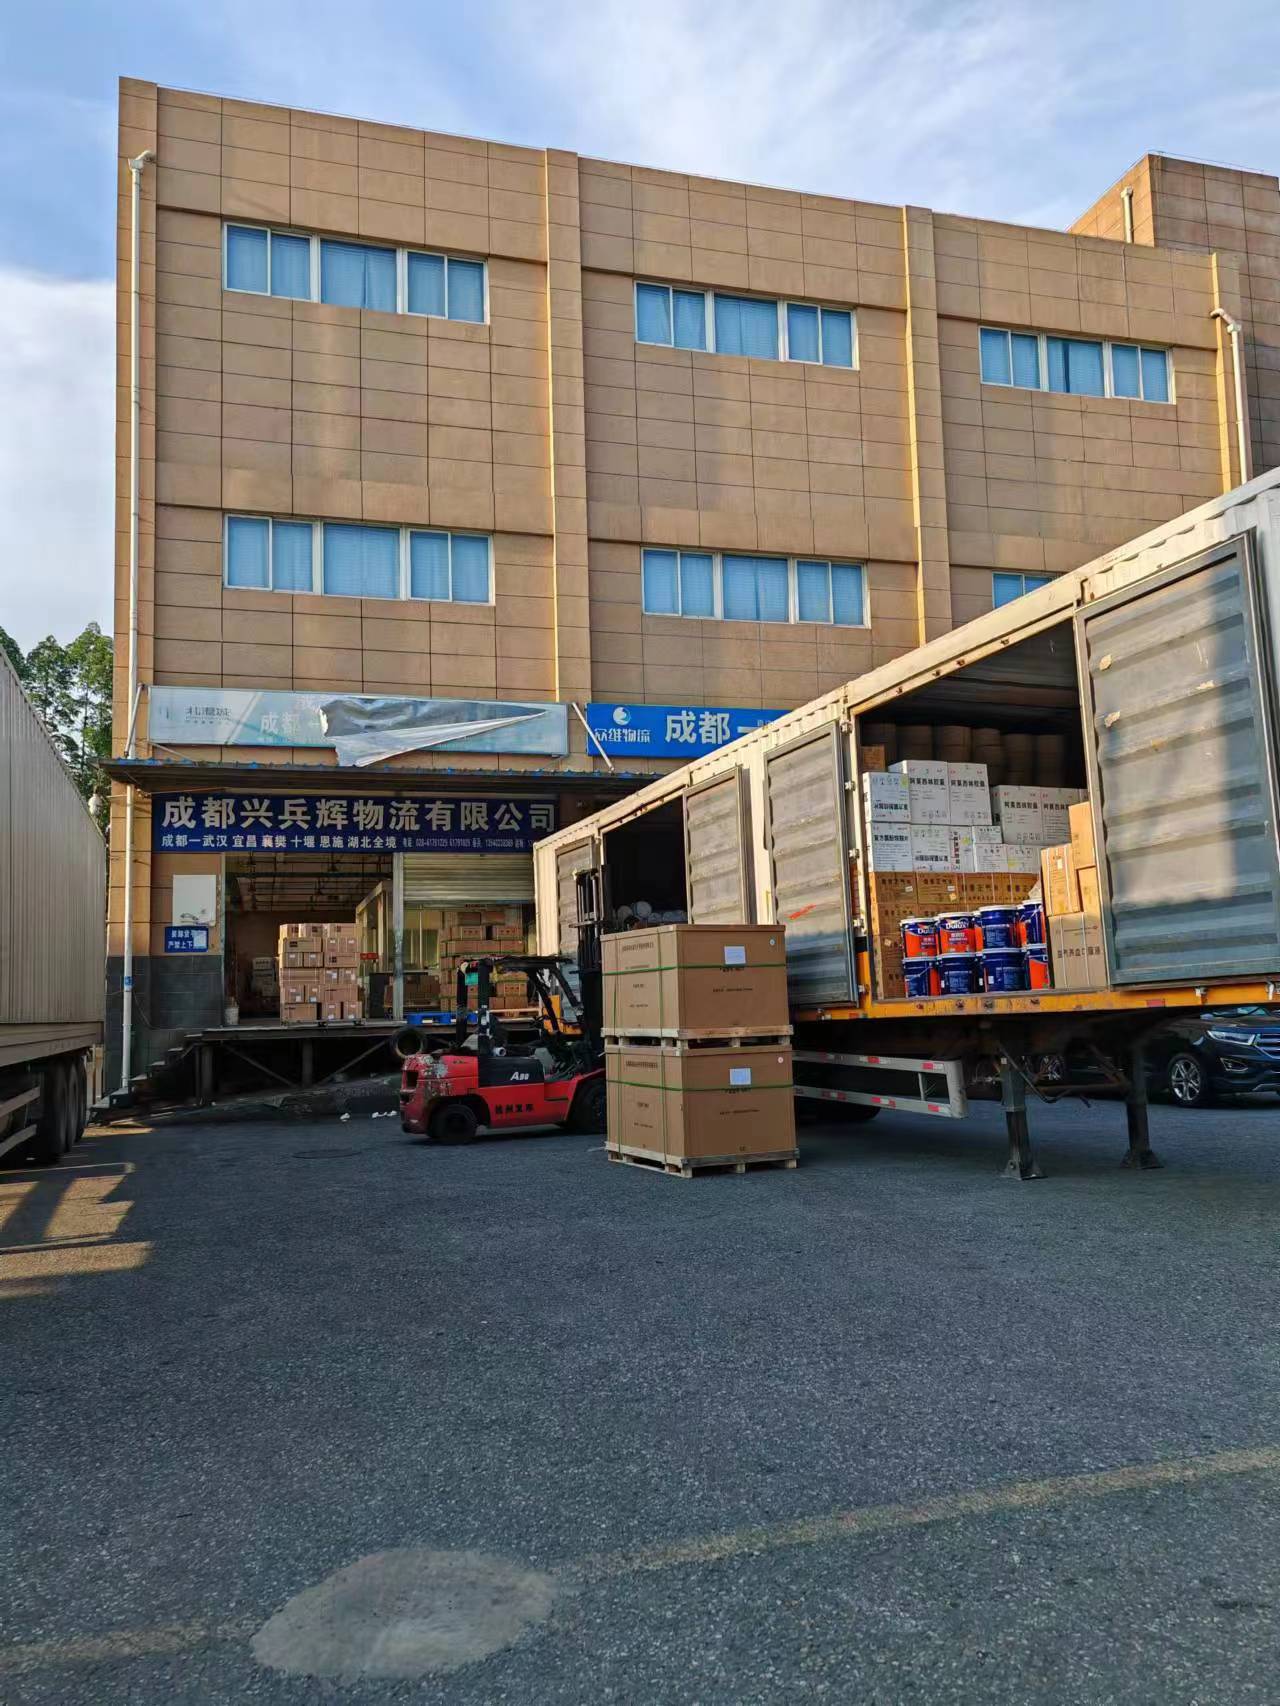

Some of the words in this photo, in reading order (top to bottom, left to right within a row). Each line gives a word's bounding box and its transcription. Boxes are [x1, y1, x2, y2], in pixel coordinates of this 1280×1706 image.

[161, 797, 555, 831] 成都兴兵辉物流有限公司
[232, 835, 258, 848] 宜昌
[261, 835, 288, 848] 襄樊
[291, 835, 316, 849] 十堰
[319, 836, 345, 849] 恩施
[348, 836, 397, 849] 湖北全境
